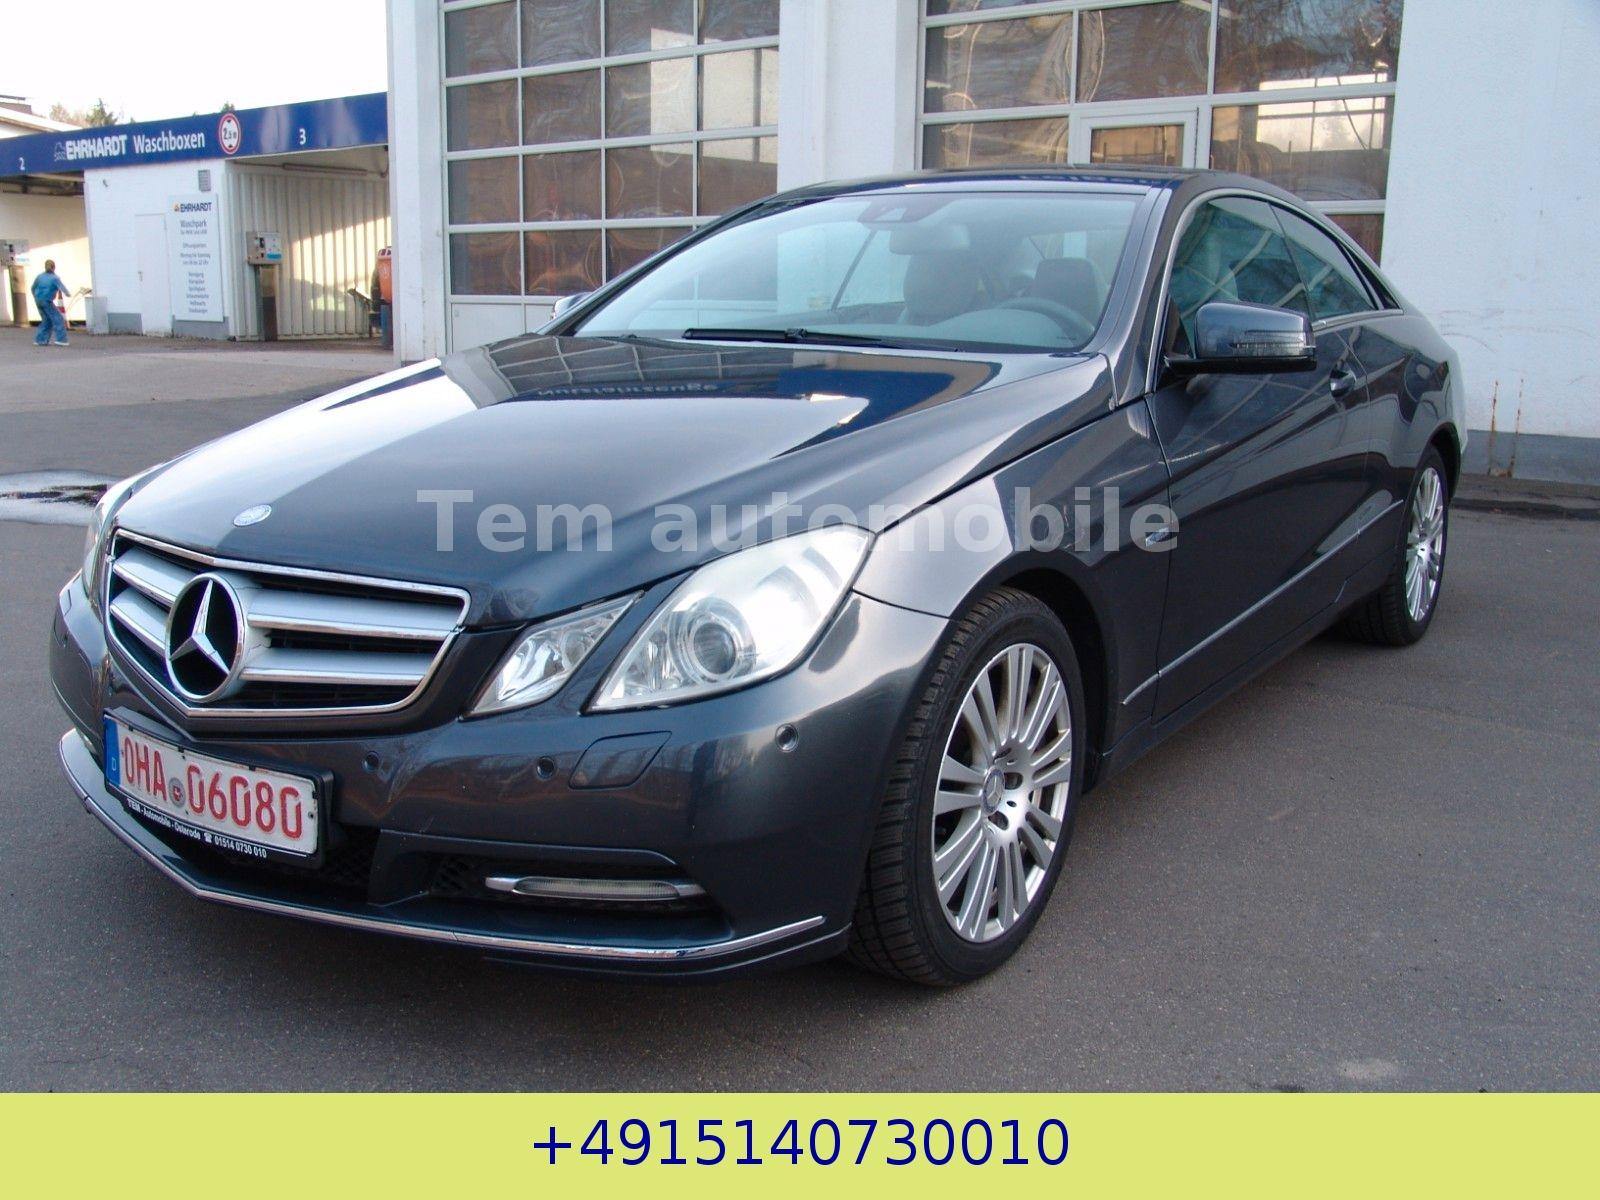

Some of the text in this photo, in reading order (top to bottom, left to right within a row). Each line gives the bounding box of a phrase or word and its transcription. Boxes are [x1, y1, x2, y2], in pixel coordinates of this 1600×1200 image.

[65, 130, 206, 160] EHRHARDT Waschboxen
[299, 128, 307, 145] 3
[18, 156, 26, 171] 2
[180, 202, 212, 213] EHRHARDT
[124, 736, 302, 839] OHA 06080
[214, 837, 235, 850] 01514
[235, 843, 253, 855] 0730
[253, 848, 267, 858] 010
